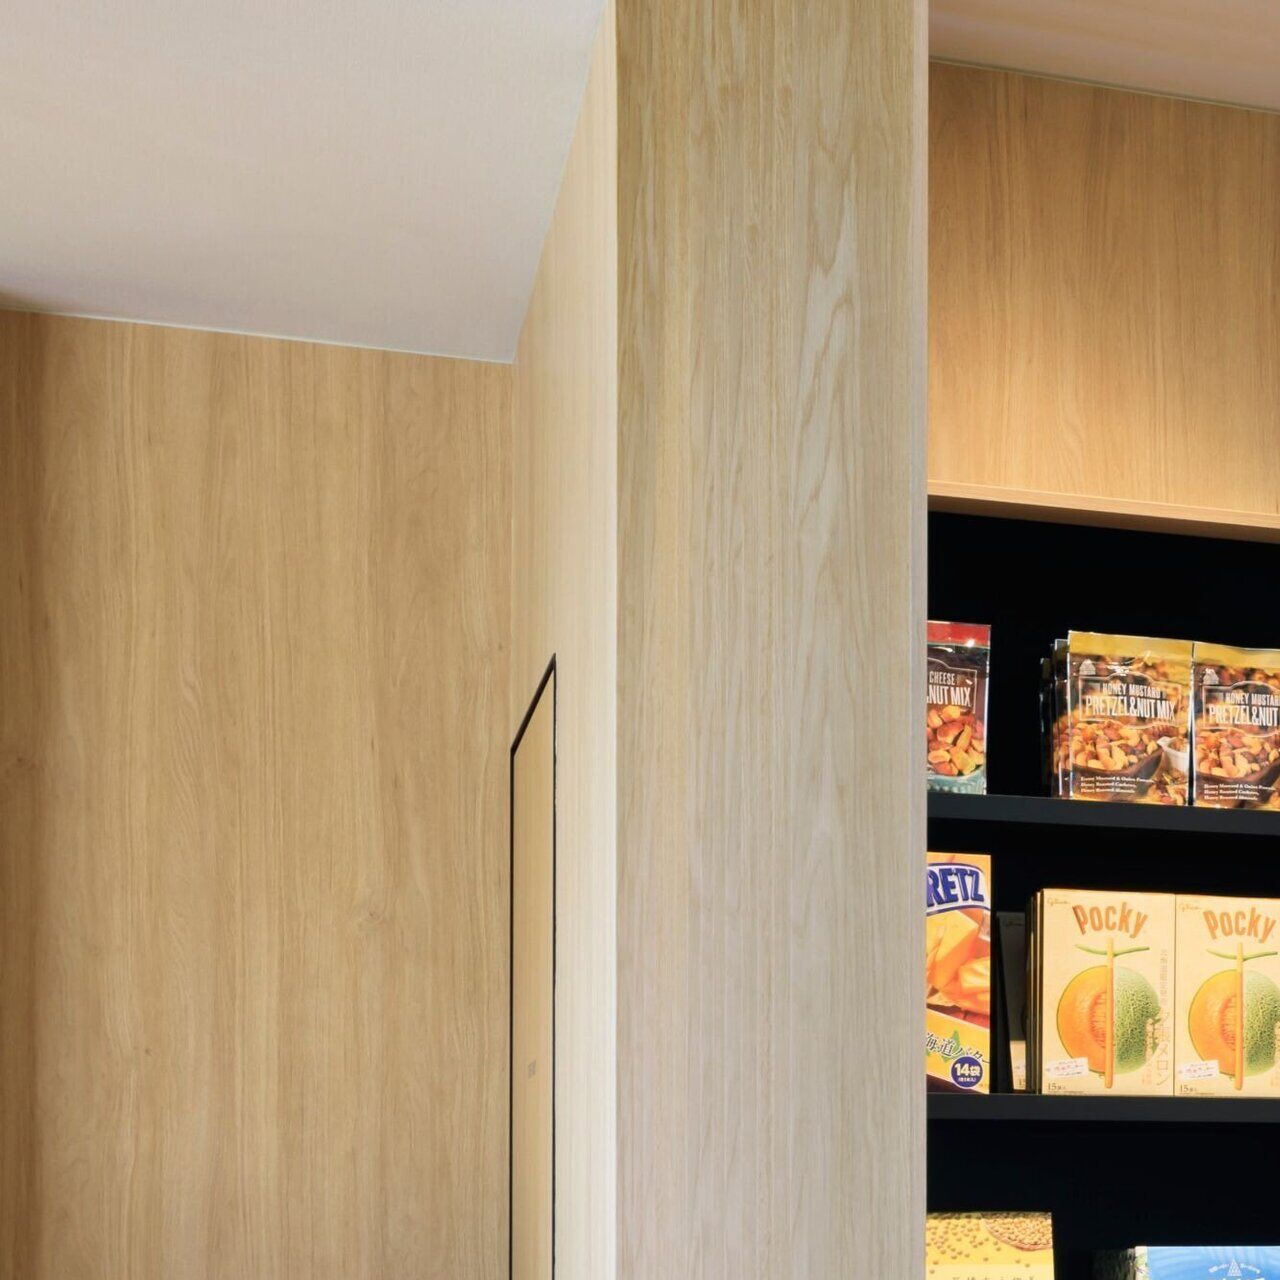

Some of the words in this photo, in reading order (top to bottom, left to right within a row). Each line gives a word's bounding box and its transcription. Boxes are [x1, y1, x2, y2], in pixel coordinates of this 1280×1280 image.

[930, 671, 955, 685] CHEESE
[951, 687, 971, 706] MIX
[1102, 683, 1127, 695] HONEY
[1129, 684, 1164, 698] MUSTARD
[1225, 693, 1249, 705] HONEY
[1157, 701, 1176, 720] MIX
